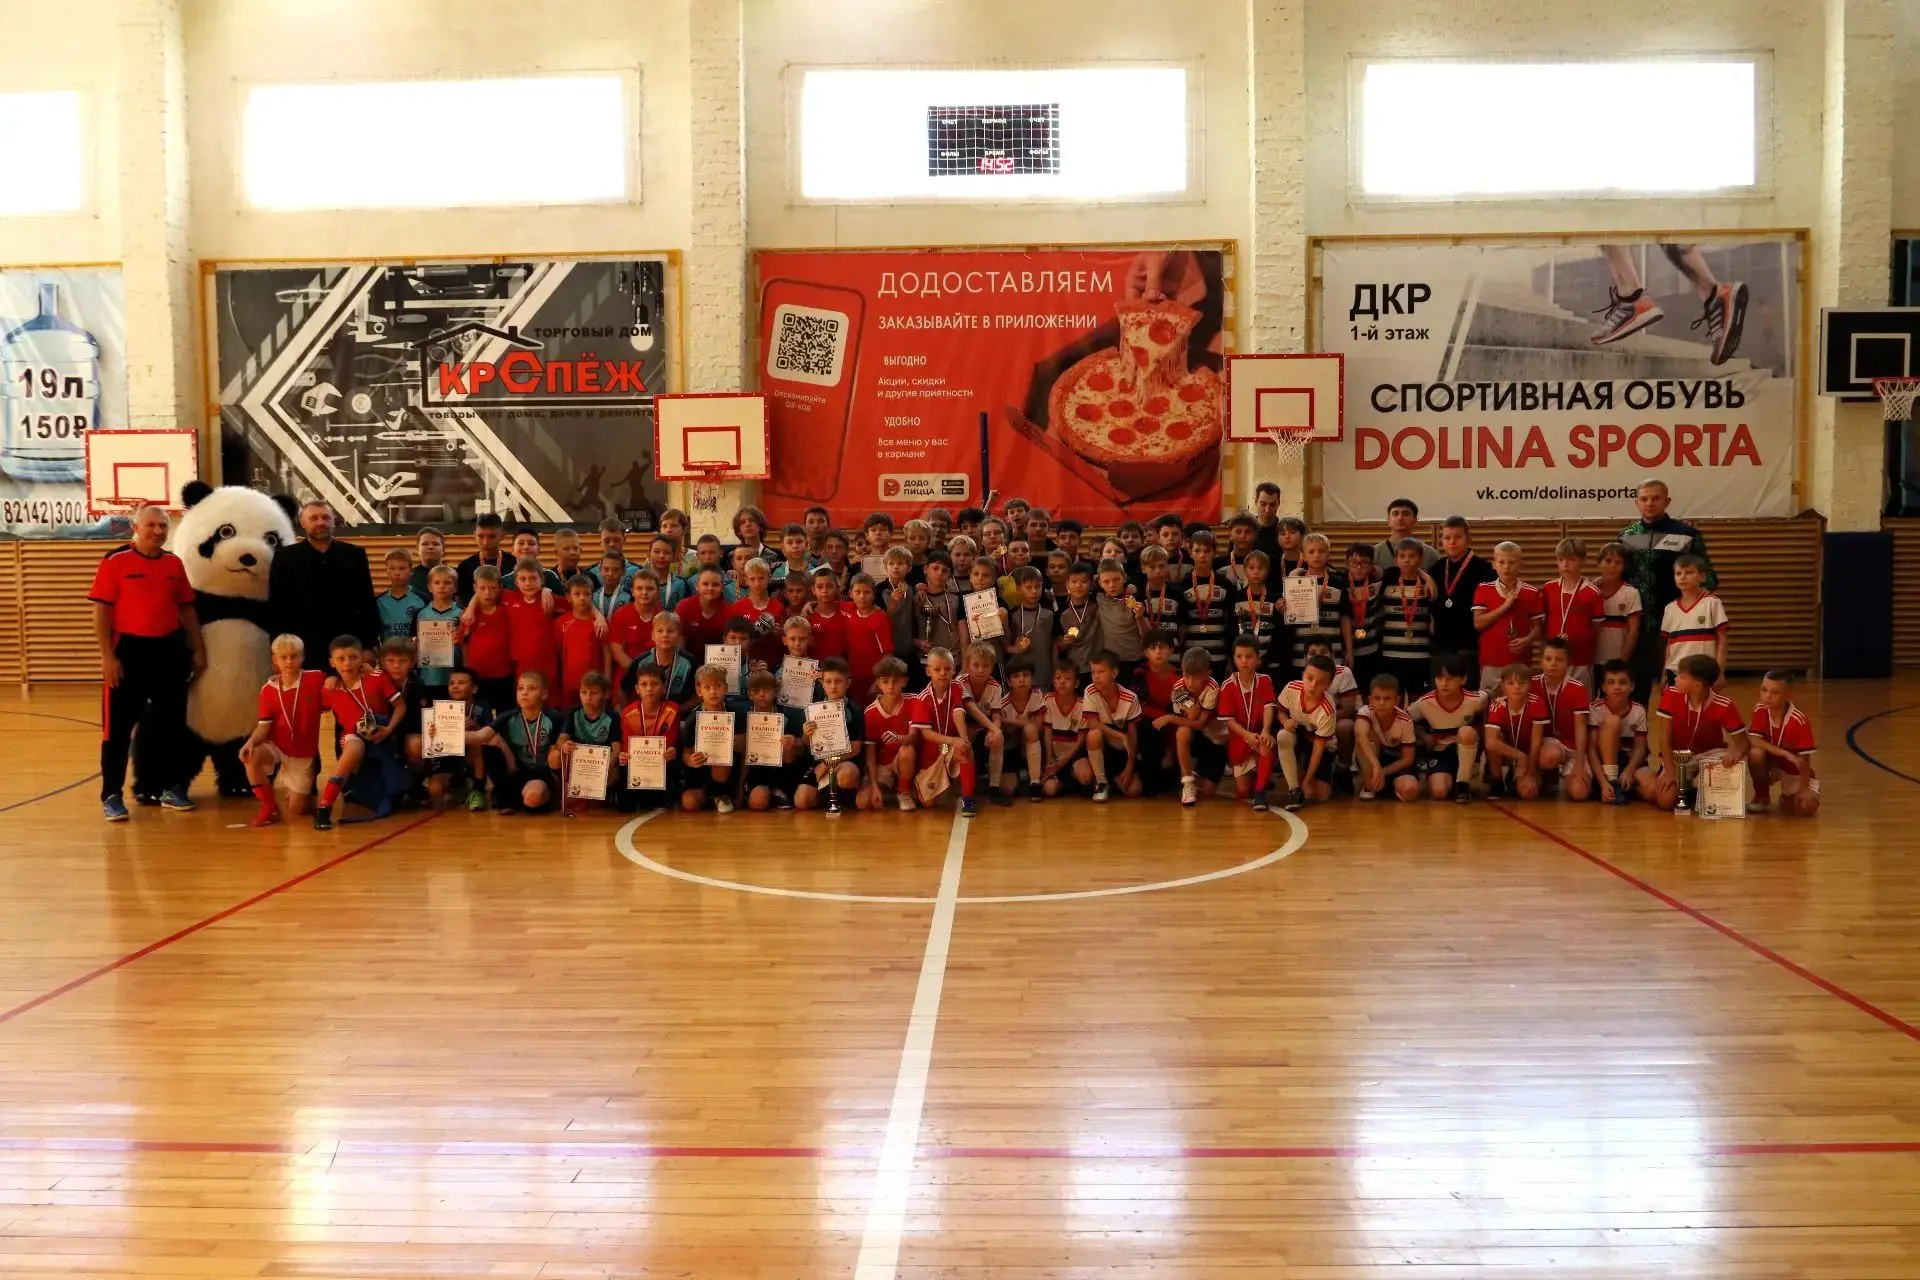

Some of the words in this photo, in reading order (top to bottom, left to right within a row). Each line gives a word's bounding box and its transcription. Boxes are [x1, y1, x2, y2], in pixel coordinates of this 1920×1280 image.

[877, 270, 1113, 299] ДОДОСТАВЛЯЕМ
[1349, 283, 1432, 321] ДКР
[878, 312, 978, 330] ЗАКАЗЫВАЙТЕ
[983, 315, 991, 329] В
[995, 314, 1097, 329] ПРИЛОЖЕНИИ
[534, 325, 614, 339] ТОРГОВЫЙ
[619, 325, 652, 339] ДОМ
[1350, 324, 1378, 341] 1-й
[1384, 328, 1430, 341] этаж
[883, 355, 927, 367] ВЫГОДНО
[877, 377, 910, 387] Акции,
[911, 378, 946, 386] скидки
[877, 390, 884, 398] и
[885, 389, 918, 399] другие
[919, 389, 973, 399] приятности
[1370, 381, 1613, 413] СПОРТИВНАЯ
[1623, 379, 1745, 411] ОБУВЬ
[428, 409, 476, 420] товары
[884, 416, 921, 428] УДОБНО
[878, 437, 894, 447] Все
[896, 438, 923, 447] меню
[931, 437, 948, 446] вас
[1354, 425, 1556, 470] DOLINA
[1567, 423, 1763, 469] SPORTA
[885, 450, 926, 459] кармане
[903, 479, 929, 488] ДОДО
[903, 487, 935, 497] ПИЦЦА
[1476, 485, 1638, 502] vk.com/dolinasporta
